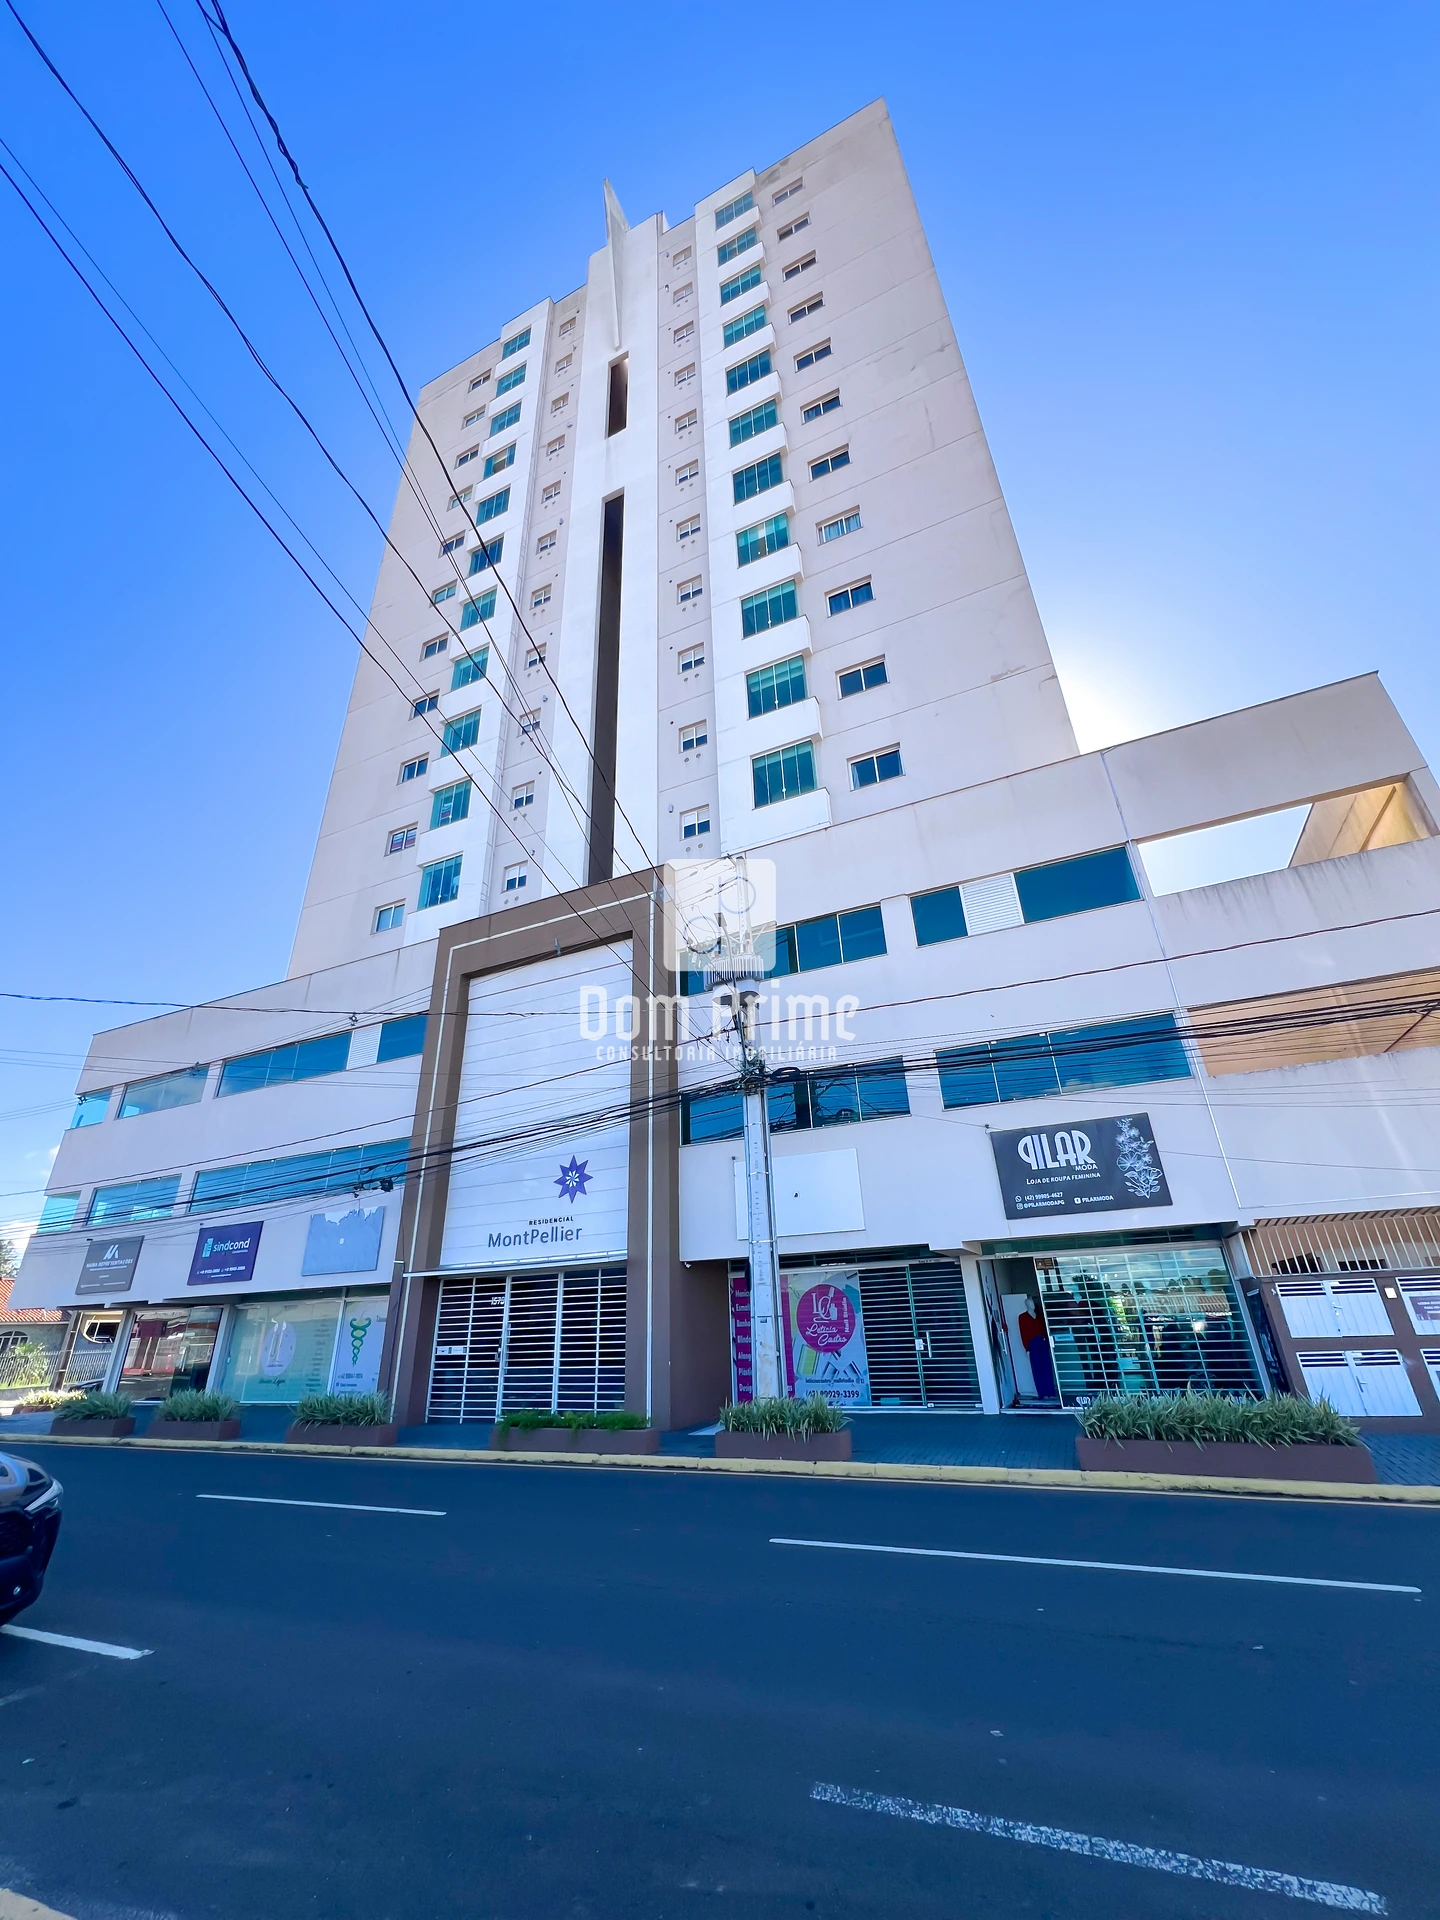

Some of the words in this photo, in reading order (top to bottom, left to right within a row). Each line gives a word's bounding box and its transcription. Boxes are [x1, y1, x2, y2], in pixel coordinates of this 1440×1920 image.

[1017, 1129, 1097, 1171] PILAR
[1075, 1164, 1098, 1172] MODA
[1042, 1176, 1050, 1184] DE
[1050, 1175, 1071, 1183] ROUPA
[1071, 1172, 1101, 1180] FEMININA
[1081, 1195, 1114, 1203] PILARMODA
[528, 1216, 574, 1226] RESIDENCIAL
[488, 1226, 582, 1248] MontPellier
[213, 1237, 251, 1252] sindcond
[817, 1333, 848, 1346] Castro
